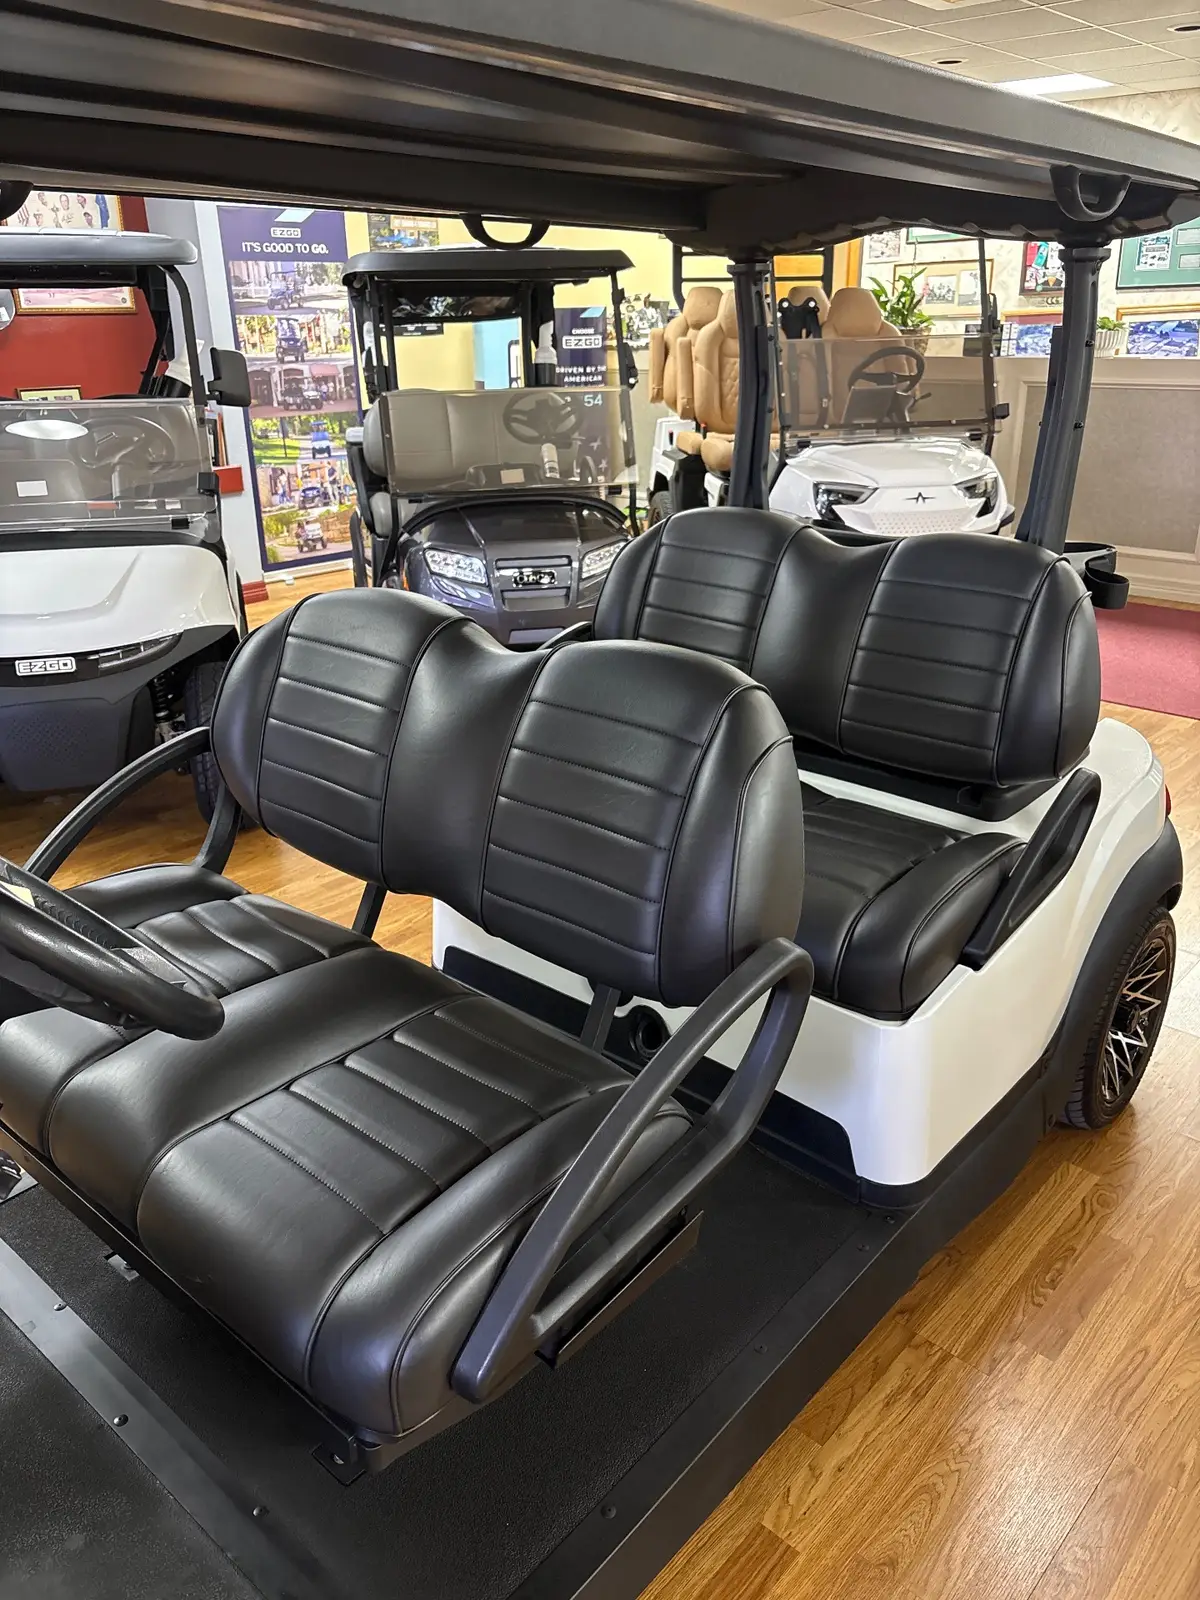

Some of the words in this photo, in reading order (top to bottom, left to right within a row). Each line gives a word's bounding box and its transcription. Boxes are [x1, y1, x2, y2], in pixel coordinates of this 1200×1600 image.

[271, 228, 300, 237] EZGO
[242, 241, 261, 252] IT'S
[263, 242, 294, 253] GOOD
[295, 243, 310, 253] TO
[311, 243, 329, 254] GO.
[564, 337, 600, 347] EZGO
[586, 365, 596, 373] BY
[18, 659, 74, 674] EZGO
